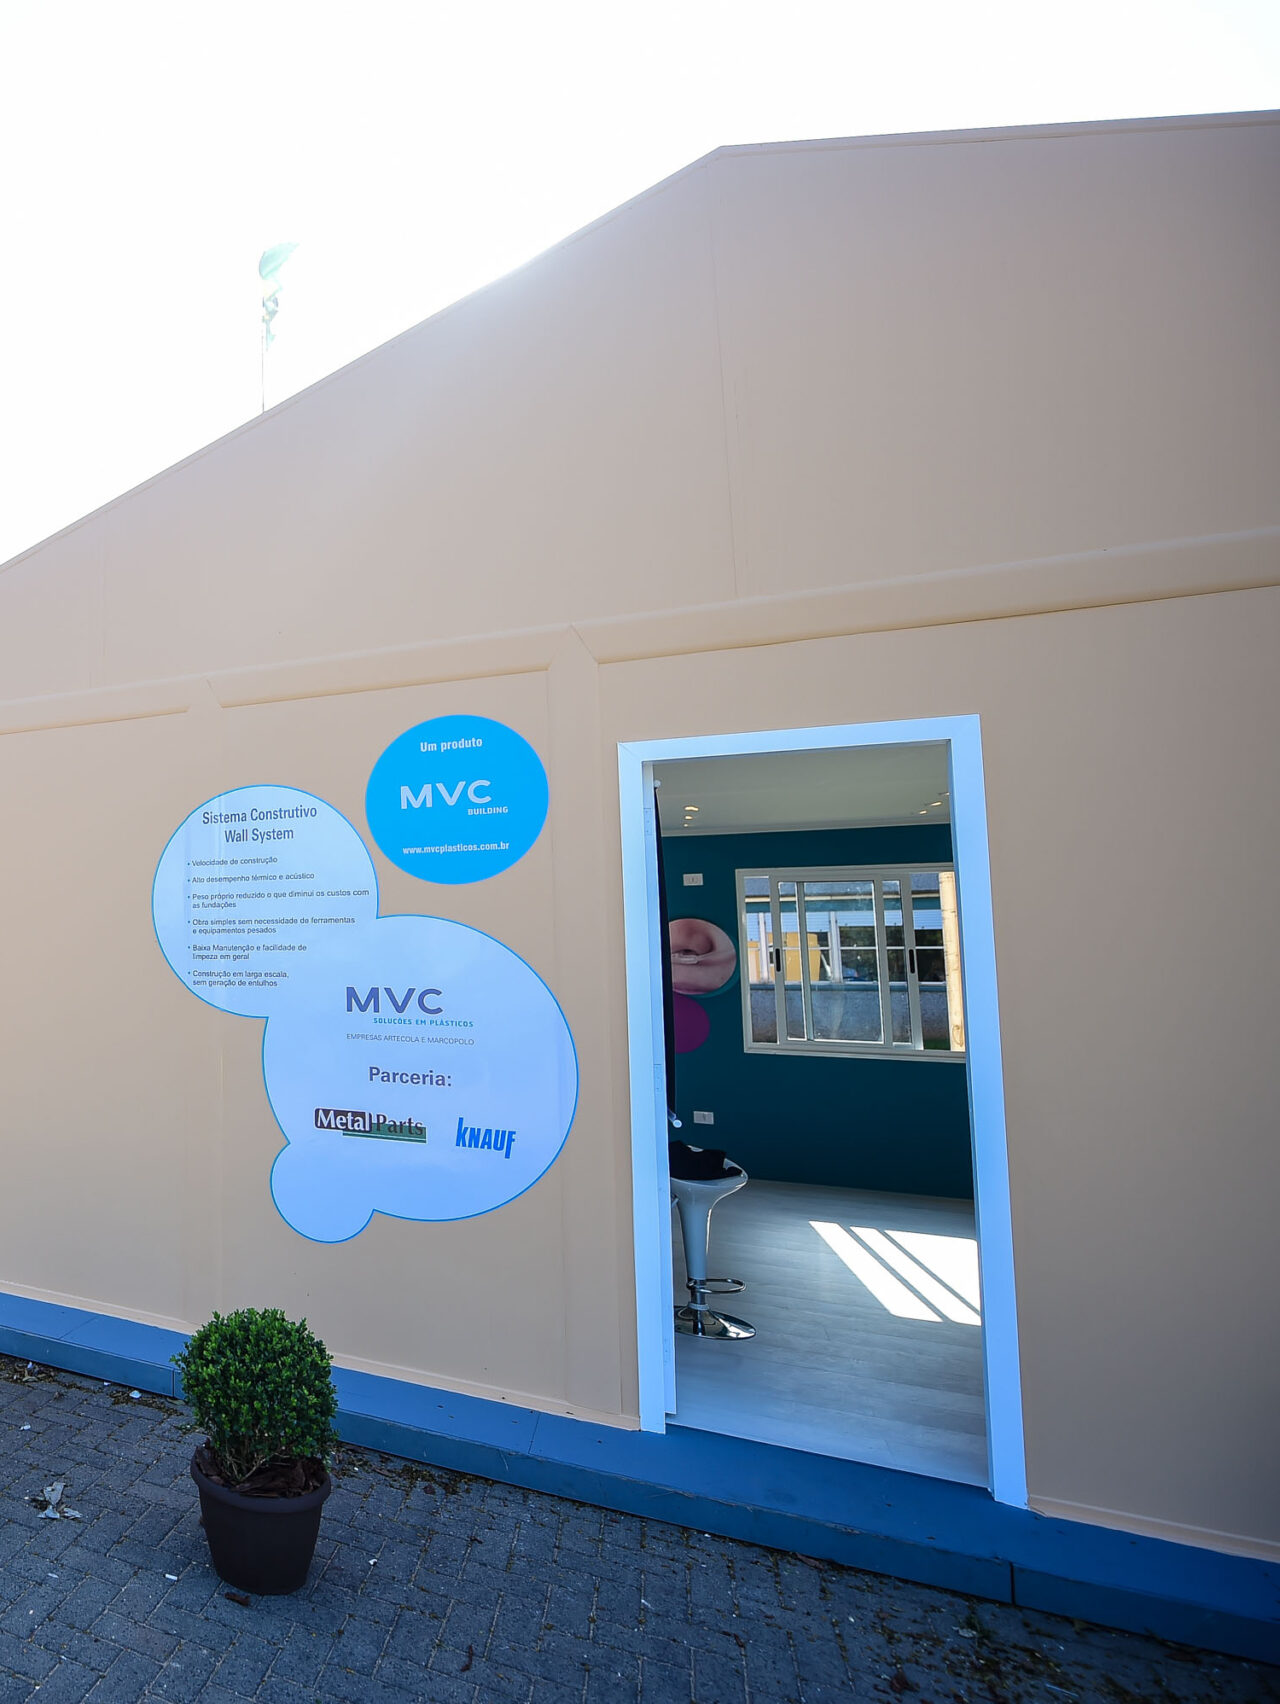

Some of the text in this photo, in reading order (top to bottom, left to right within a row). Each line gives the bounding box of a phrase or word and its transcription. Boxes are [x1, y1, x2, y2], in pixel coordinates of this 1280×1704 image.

[420, 737, 483, 752] Um produto
[400, 779, 492, 810] MVC
[202, 805, 318, 824] Sistema Construtivo
[467, 806, 509, 816] BUILDING
[224, 828, 294, 844] Wall System
[402, 841, 510, 854] www.mvcplasticos.com.br
[192, 859, 228, 867] Velocidade
[240, 856, 278, 866] construção
[206, 874, 250, 884] desempenho
[251, 873, 277, 881] térmico
[285, 872, 315, 880] acústico
[210, 893, 234, 902] próprio
[273, 892, 287, 900] que
[288, 890, 314, 898] diminui
[201, 901, 236, 910] fundações
[210, 918, 236, 927] simples
[254, 917, 298, 925] necessidade
[311, 916, 355, 924] ferramentas
[198, 927, 245, 935] equipamentos
[247, 926, 277, 935] pesados
[212, 943, 255, 953] Manutenção
[262, 943, 295, 951] facilidade
[192, 953, 218, 961] limpeza
[232, 953, 250, 961] geral
[192, 970, 231, 979] Construção
[245, 970, 262, 979] larga
[264, 971, 289, 979] escala,
[208, 979, 236, 987] geração
[248, 979, 278, 987] entulhos
[345, 986, 443, 1015] MVC
[373, 1017, 412, 1026] SOLUÇÕES
[429, 1019, 474, 1028] PLÁSTICOS
[346, 1033, 383, 1041] EMPRESAS
[383, 1035, 420, 1043] ARTECOLA
[427, 1037, 475, 1046] MARCOPOLO
[369, 1066, 452, 1087] Parceria:
[316, 1109, 424, 1136] Metal Parts
[455, 1117, 516, 1159] KNAUF
